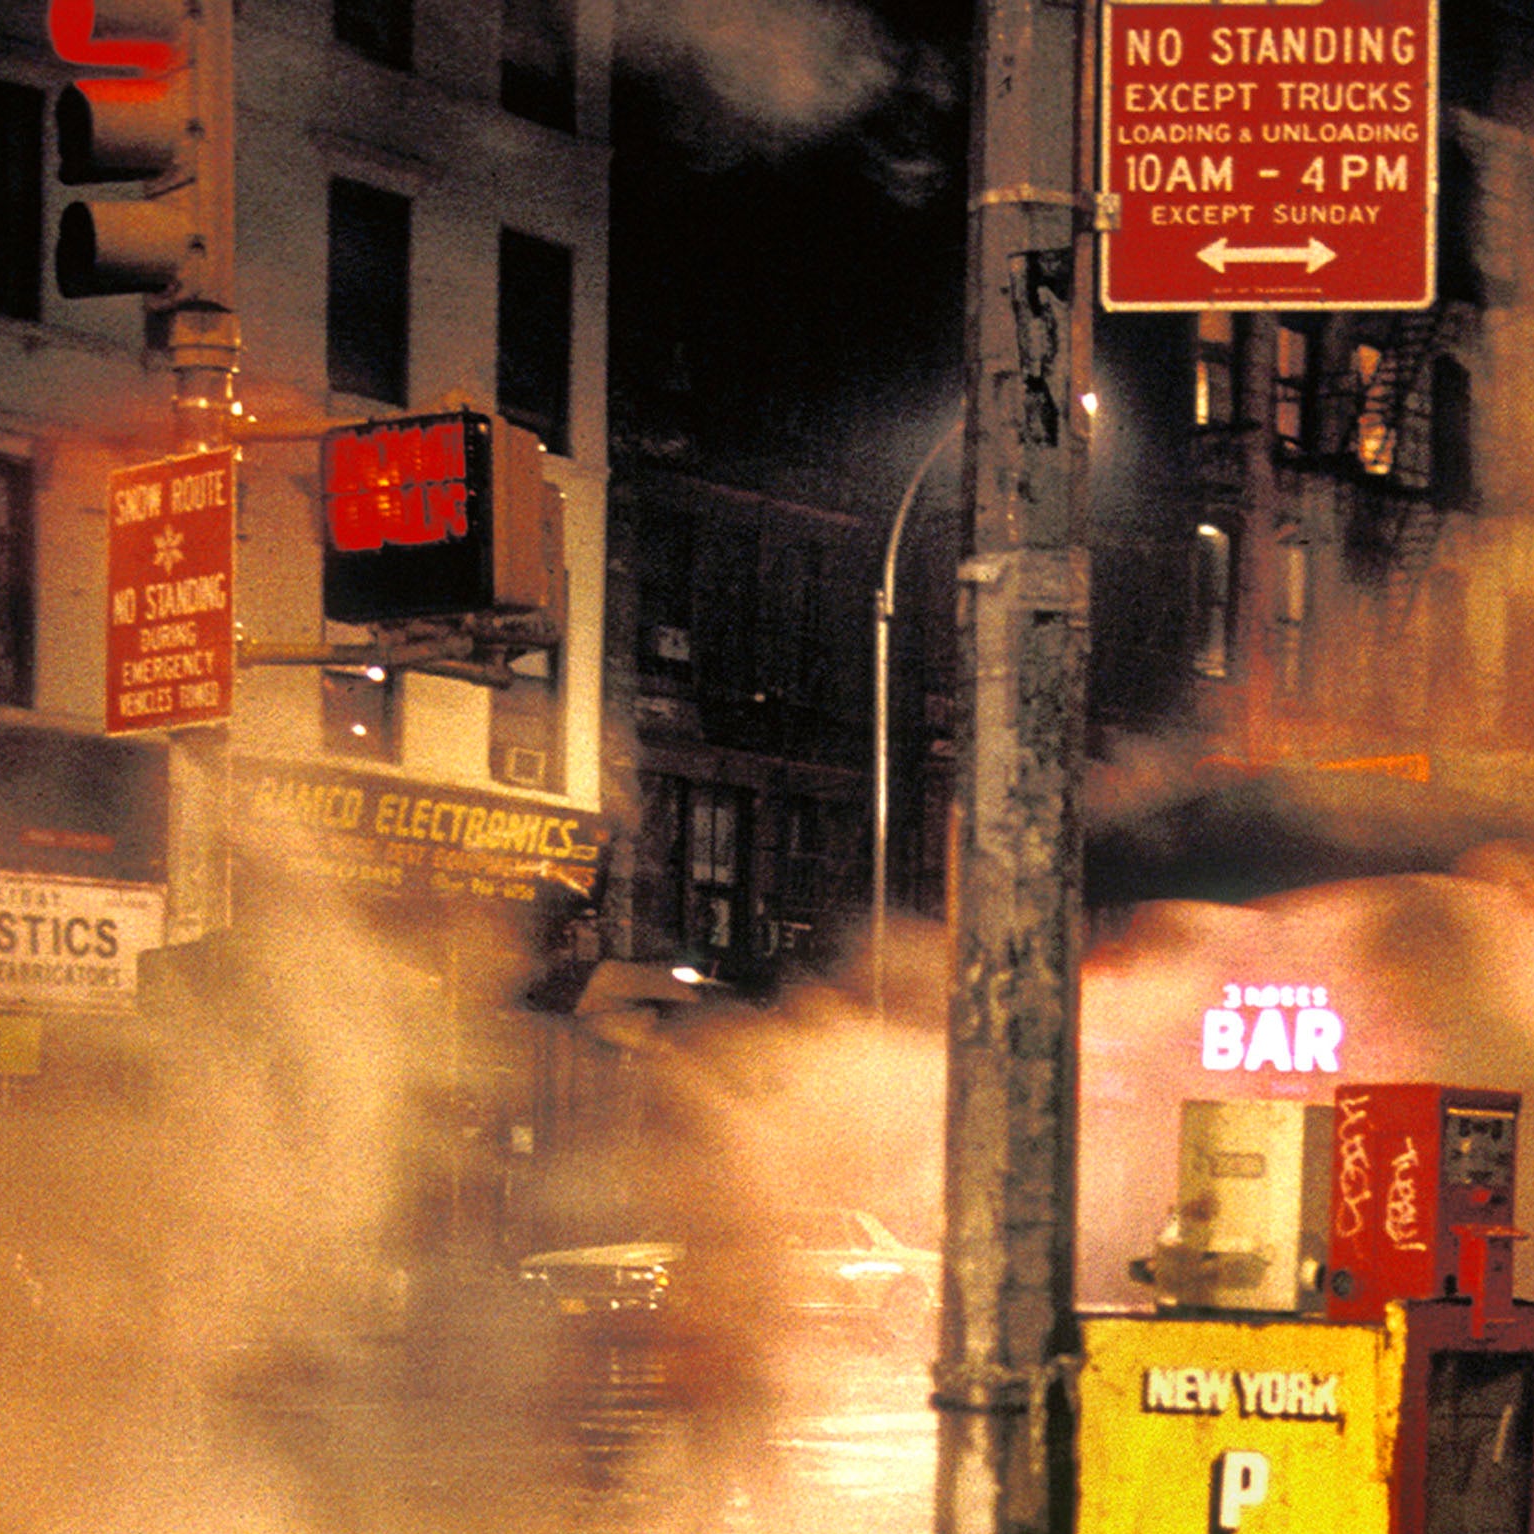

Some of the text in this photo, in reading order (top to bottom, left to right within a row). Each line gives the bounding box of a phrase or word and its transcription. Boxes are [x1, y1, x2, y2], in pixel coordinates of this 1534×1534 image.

[1127, 26, 1416, 66] NO STANDING
[1125, 82, 1413, 112] EXCEPT TRUCKS
[1118, 123, 1419, 145] LOADING & UNLOADING
[1126, 154, 1234, 193] 10AM
[1151, 203, 1380, 226] EXCEPT SUNDAY
[114, 469, 227, 526] SNOW ROUTE
[113, 573, 226, 626] NO STANDING
[140, 621, 197, 653] DURING
[122, 649, 215, 687] EMERGENCY
[118, 686, 173, 718] VEHICLES
[375, 793, 579, 858] ELECTRONICS
[1202, 1007, 1343, 1073] BAR
[1143, 1366, 1341, 1423] NEW YORK
